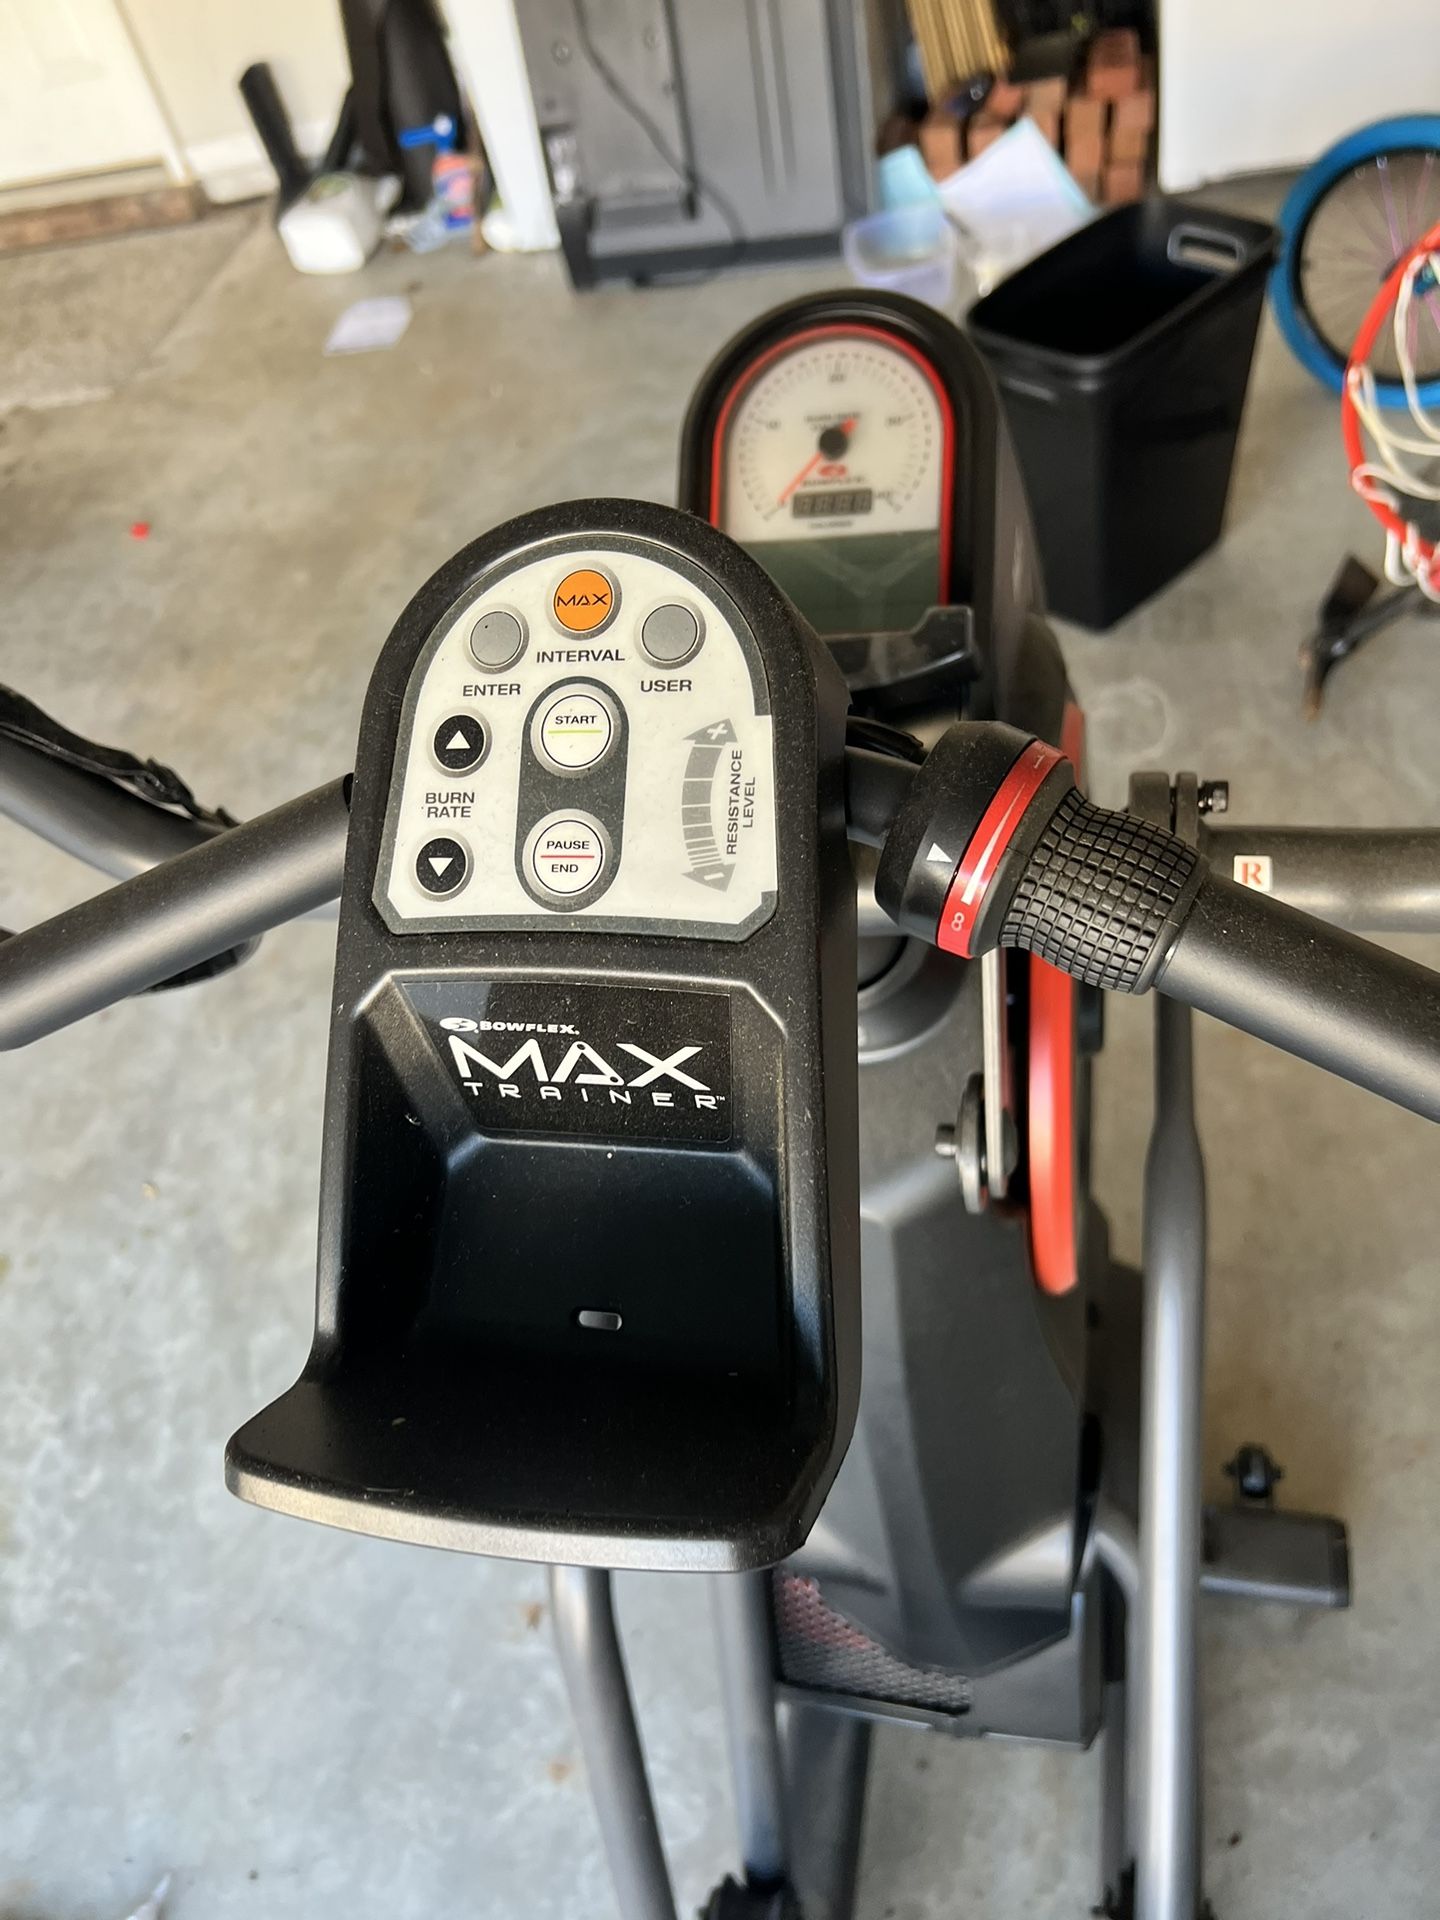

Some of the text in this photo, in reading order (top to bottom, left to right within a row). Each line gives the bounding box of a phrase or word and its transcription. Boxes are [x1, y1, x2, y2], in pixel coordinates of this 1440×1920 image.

[557, 593, 609, 607] MAX
[536, 649, 626, 664] INTERVAL
[462, 683, 522, 697] ENTER
[640, 679, 693, 693] USER
[554, 715, 598, 726] START
[425, 792, 475, 804] BURN
[726, 749, 743, 855] RESISTANCE
[743, 777, 756, 828] LEVEL
[426, 806, 472, 819] RATE
[546, 840, 590, 851] PAUSE
[551, 863, 579, 874] END
[1241, 863, 1262, 885] R
[951, 912, 964, 932] 8
[479, 1020, 576, 1035] BOWFLEX
[448, 1034, 711, 1091] MAX
